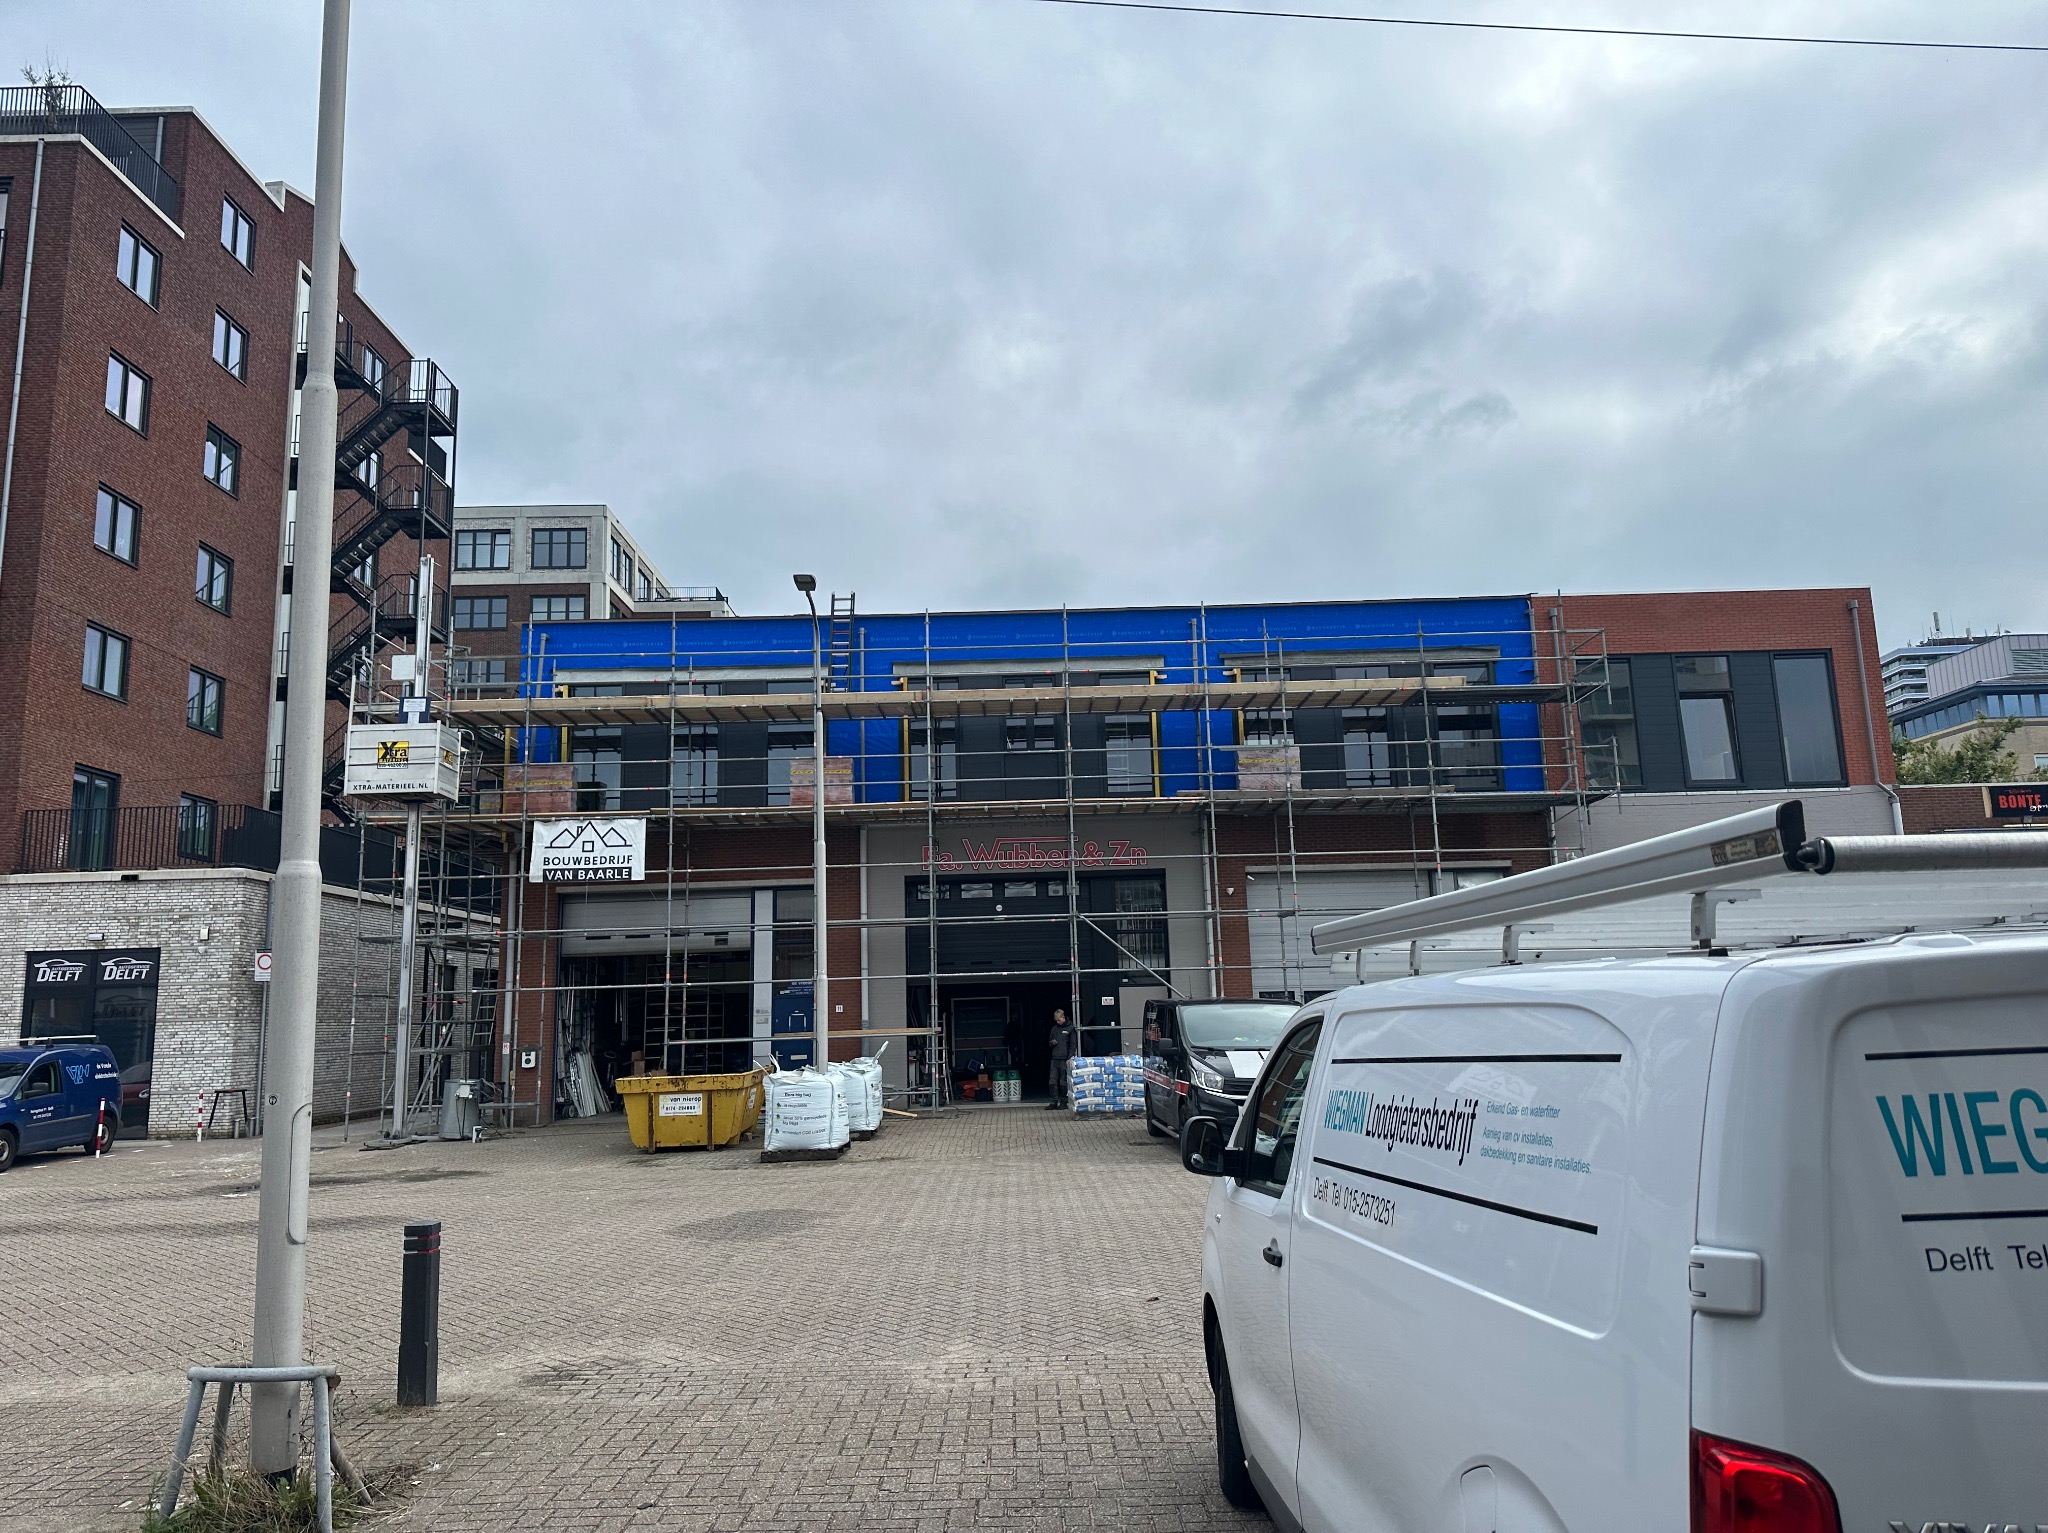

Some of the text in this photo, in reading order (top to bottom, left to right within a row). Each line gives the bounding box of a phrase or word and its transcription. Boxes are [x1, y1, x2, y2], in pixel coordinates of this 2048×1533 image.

[380, 741, 407, 760] Xtra
[352, 783, 429, 791] XTRA-MATERIEEL.NL
[543, 855, 633, 866] BOUWBEDRIJF
[962, 836, 1079, 870] Wubben
[1081, 841, 1104, 867] &
[1108, 840, 1148, 867] Zn
[545, 868, 630, 880] VAN BAARLE
[36, 967, 83, 982] DELFT
[103, 965, 150, 981] DELFT
[1521, 1106, 1529, 1116] en
[1324, 1089, 1478, 1166] WIEGMAN Loodgietersbedrijf
[1502, 1130, 1513, 1141] van
[1875, 1088, 2048, 1177] WIEG
[1517, 1152, 1526, 1163] en
[1526, 1151, 1553, 1168] sanitaire
[1313, 1177, 1396, 1227] Delft Tel 015-2573251
[1925, 1244, 2048, 1272] Delft Tel
